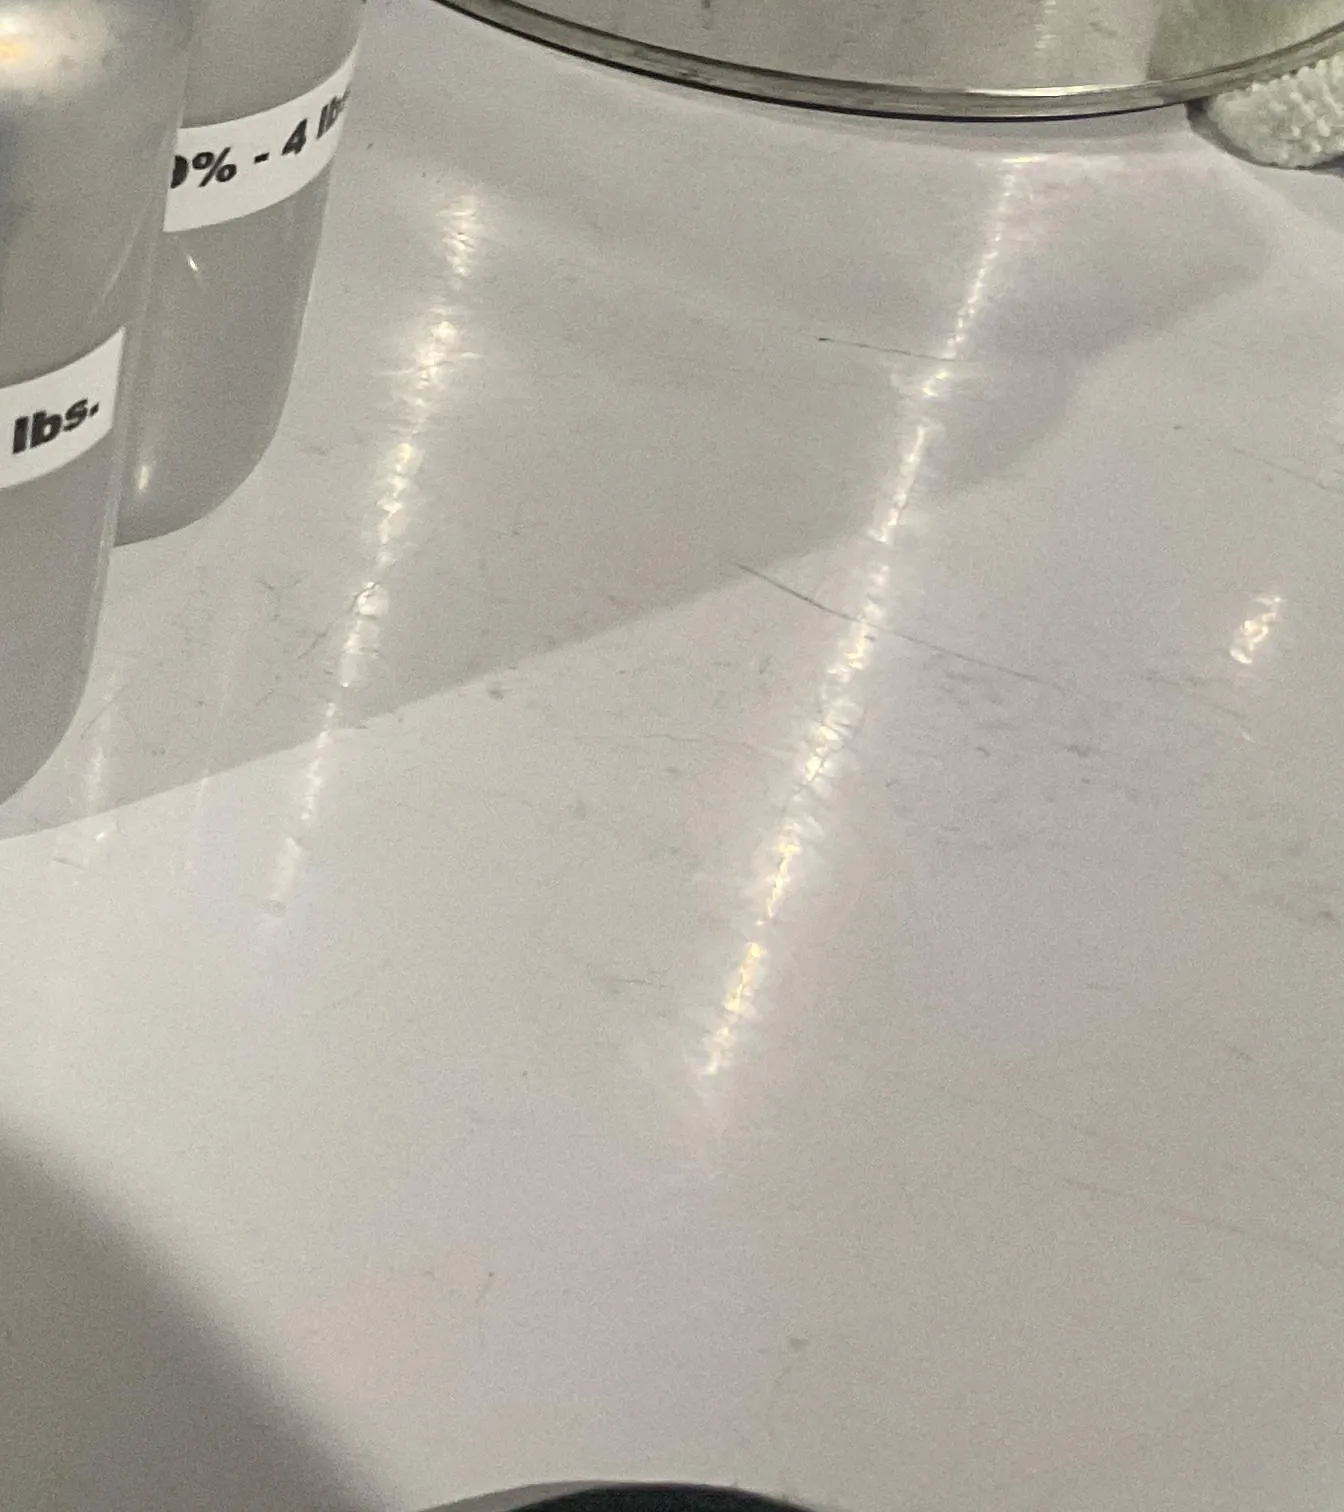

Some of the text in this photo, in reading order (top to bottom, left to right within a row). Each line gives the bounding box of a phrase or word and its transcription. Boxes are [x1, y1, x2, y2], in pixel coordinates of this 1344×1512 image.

[254, 152, 269, 164] -
[281, 118, 308, 156] 4
[12, 395, 100, 456] lbs.
